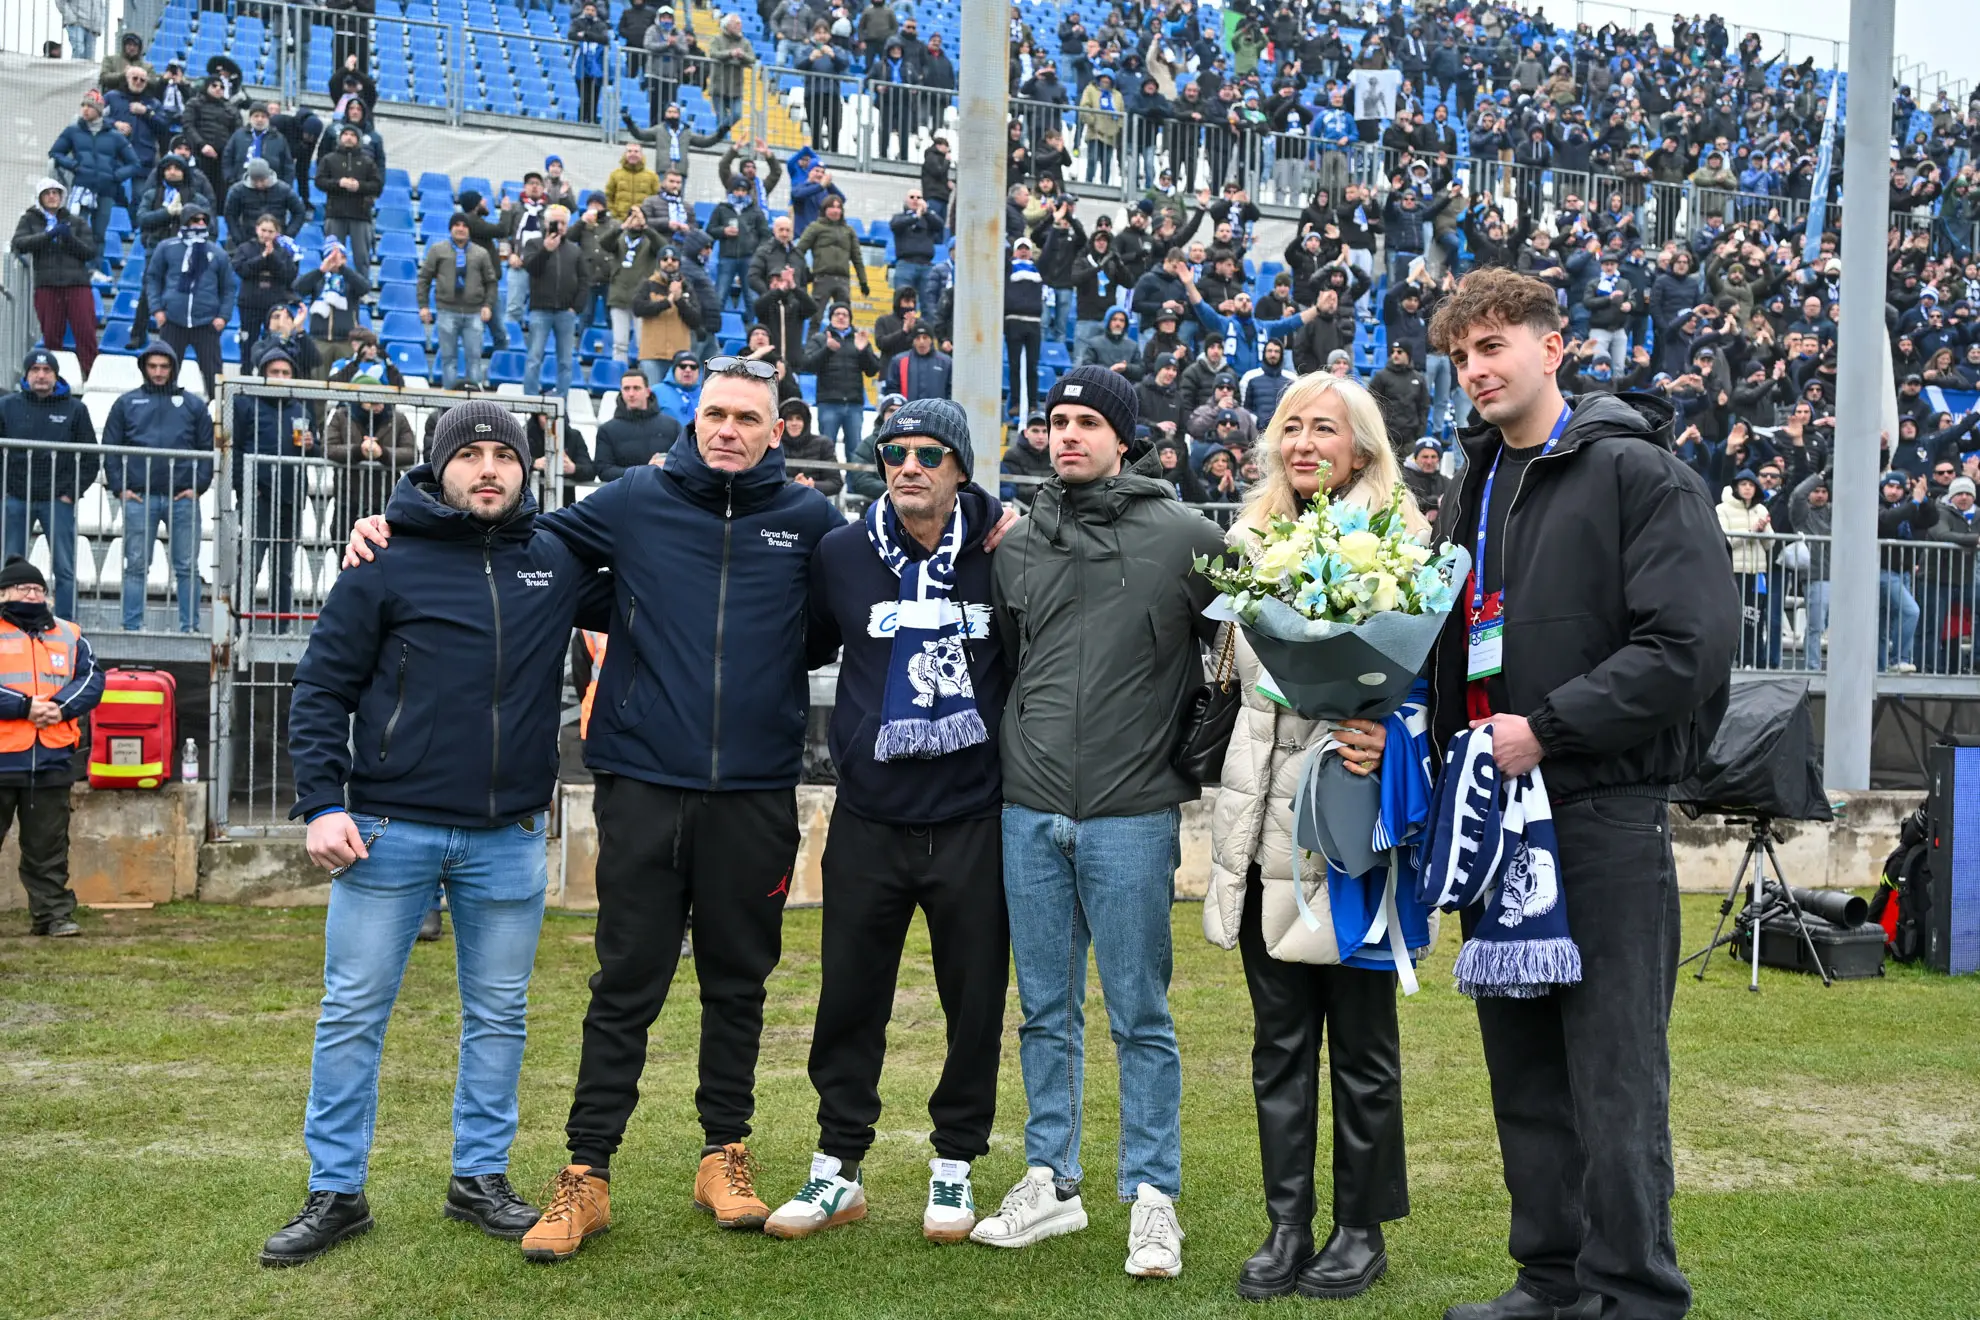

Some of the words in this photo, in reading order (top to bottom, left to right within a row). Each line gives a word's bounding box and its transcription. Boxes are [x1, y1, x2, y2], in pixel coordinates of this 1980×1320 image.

[761, 529, 780, 538] Curva
[781, 531, 799, 540] Nord
[768, 537, 792, 547] Brescia
[517, 570, 536, 578] Curva
[536, 570, 553, 578] Nord
[525, 578, 549, 586] Brescia
